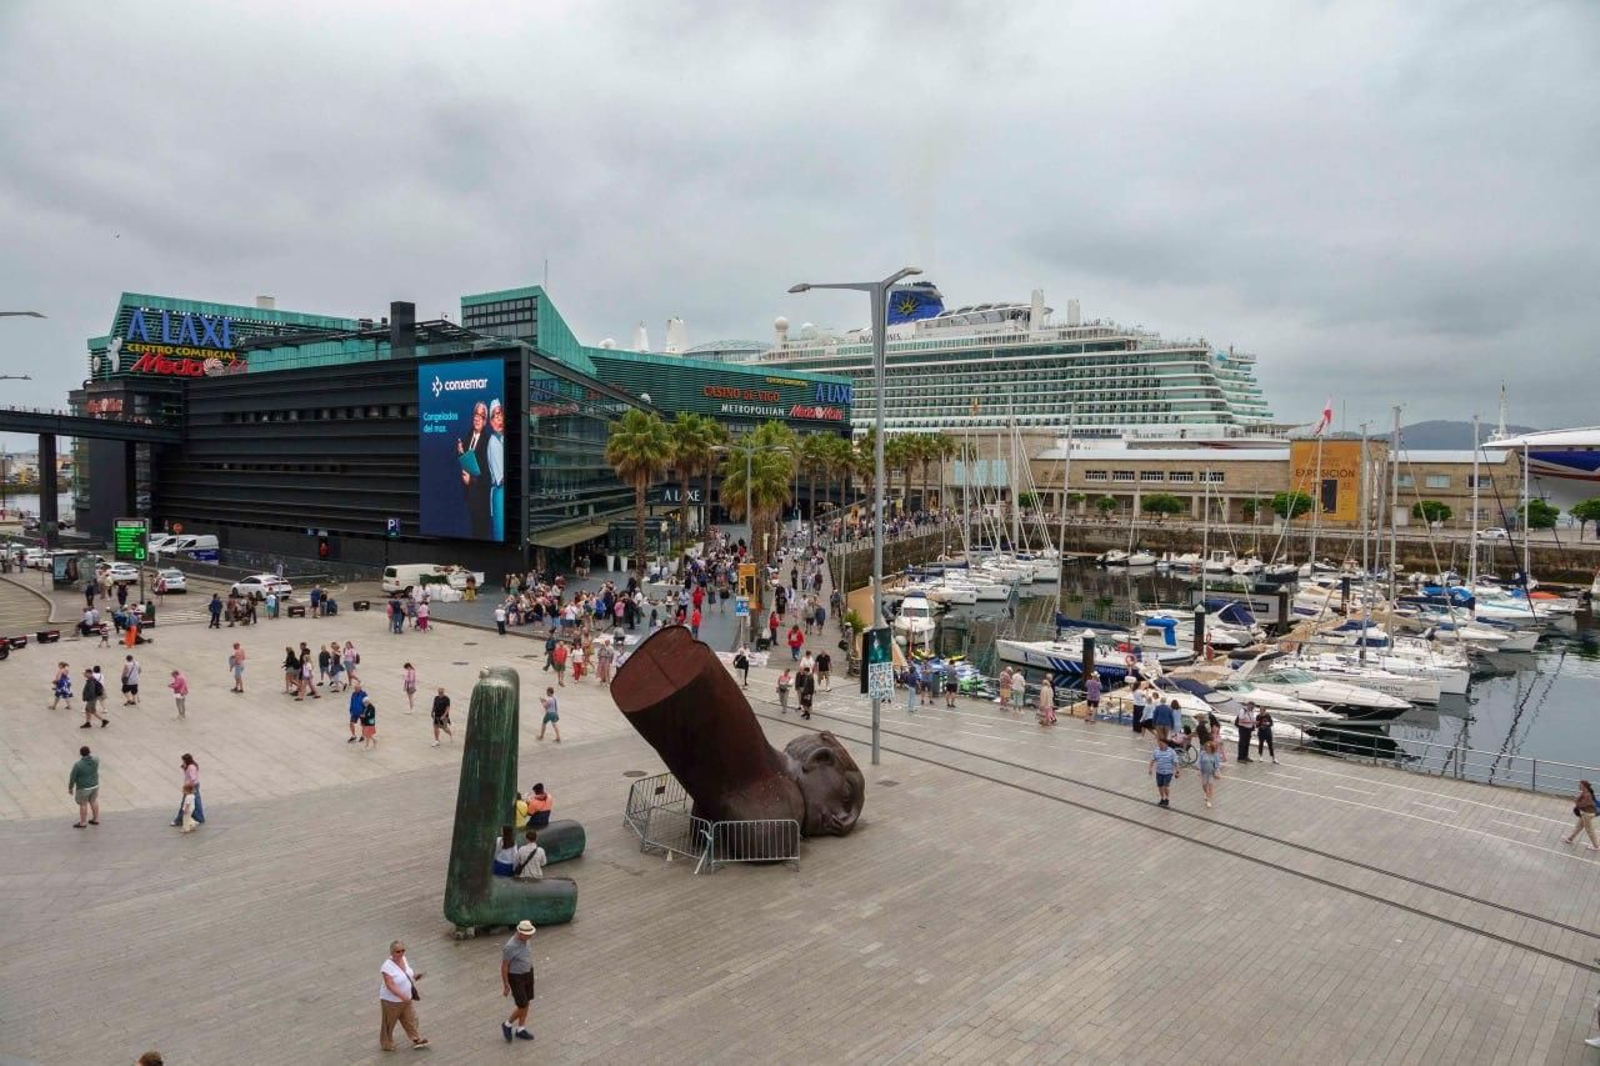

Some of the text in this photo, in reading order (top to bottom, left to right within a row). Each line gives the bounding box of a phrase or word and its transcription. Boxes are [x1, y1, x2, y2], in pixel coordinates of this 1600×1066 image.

[127, 309, 151, 342] A
[127, 343, 237, 360] CENTRO COMERCIAL
[445, 379, 488, 390] conxemar
[704, 385, 740, 398] CASINO
[759, 390, 780, 402] VIGO
[816, 382, 824, 402] A
[721, 404, 785, 416] METROPOLITAN
[423, 411, 458, 422] Congelados
[423, 424, 433, 433] del
[664, 489, 700, 501] A LXE
[388, 519, 396, 530] P
